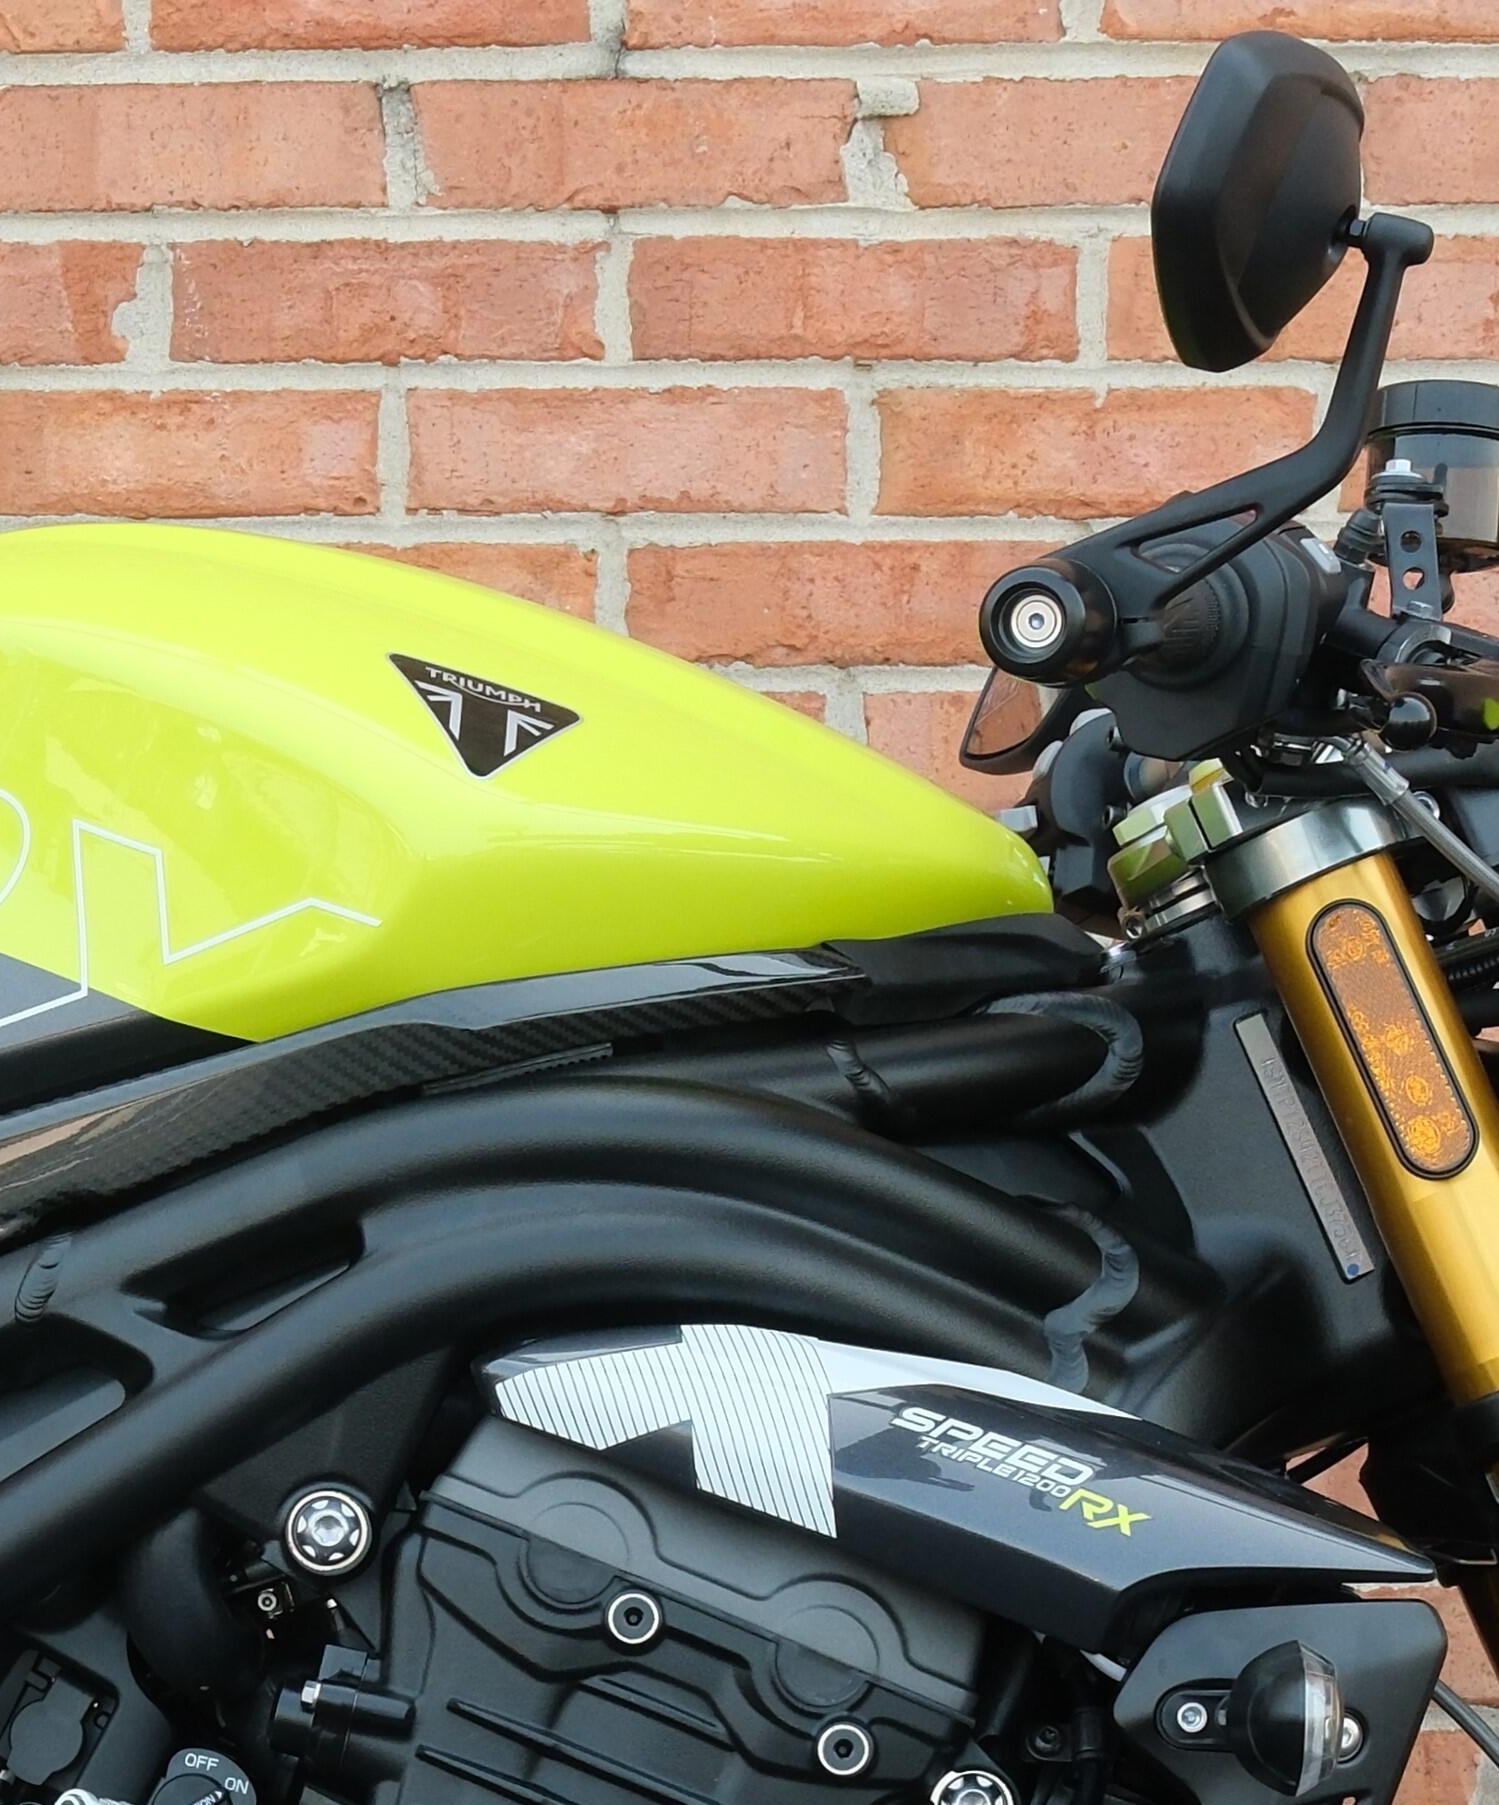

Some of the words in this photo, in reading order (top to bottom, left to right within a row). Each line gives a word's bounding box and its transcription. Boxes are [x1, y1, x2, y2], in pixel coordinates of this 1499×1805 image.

[425, 666, 541, 712] TRIUMPH
[889, 1406, 1095, 1487] SPEED
[1058, 1488, 1152, 1537] RX
[184, 1752, 220, 1771] OFF
[224, 1777, 250, 1795] ON
